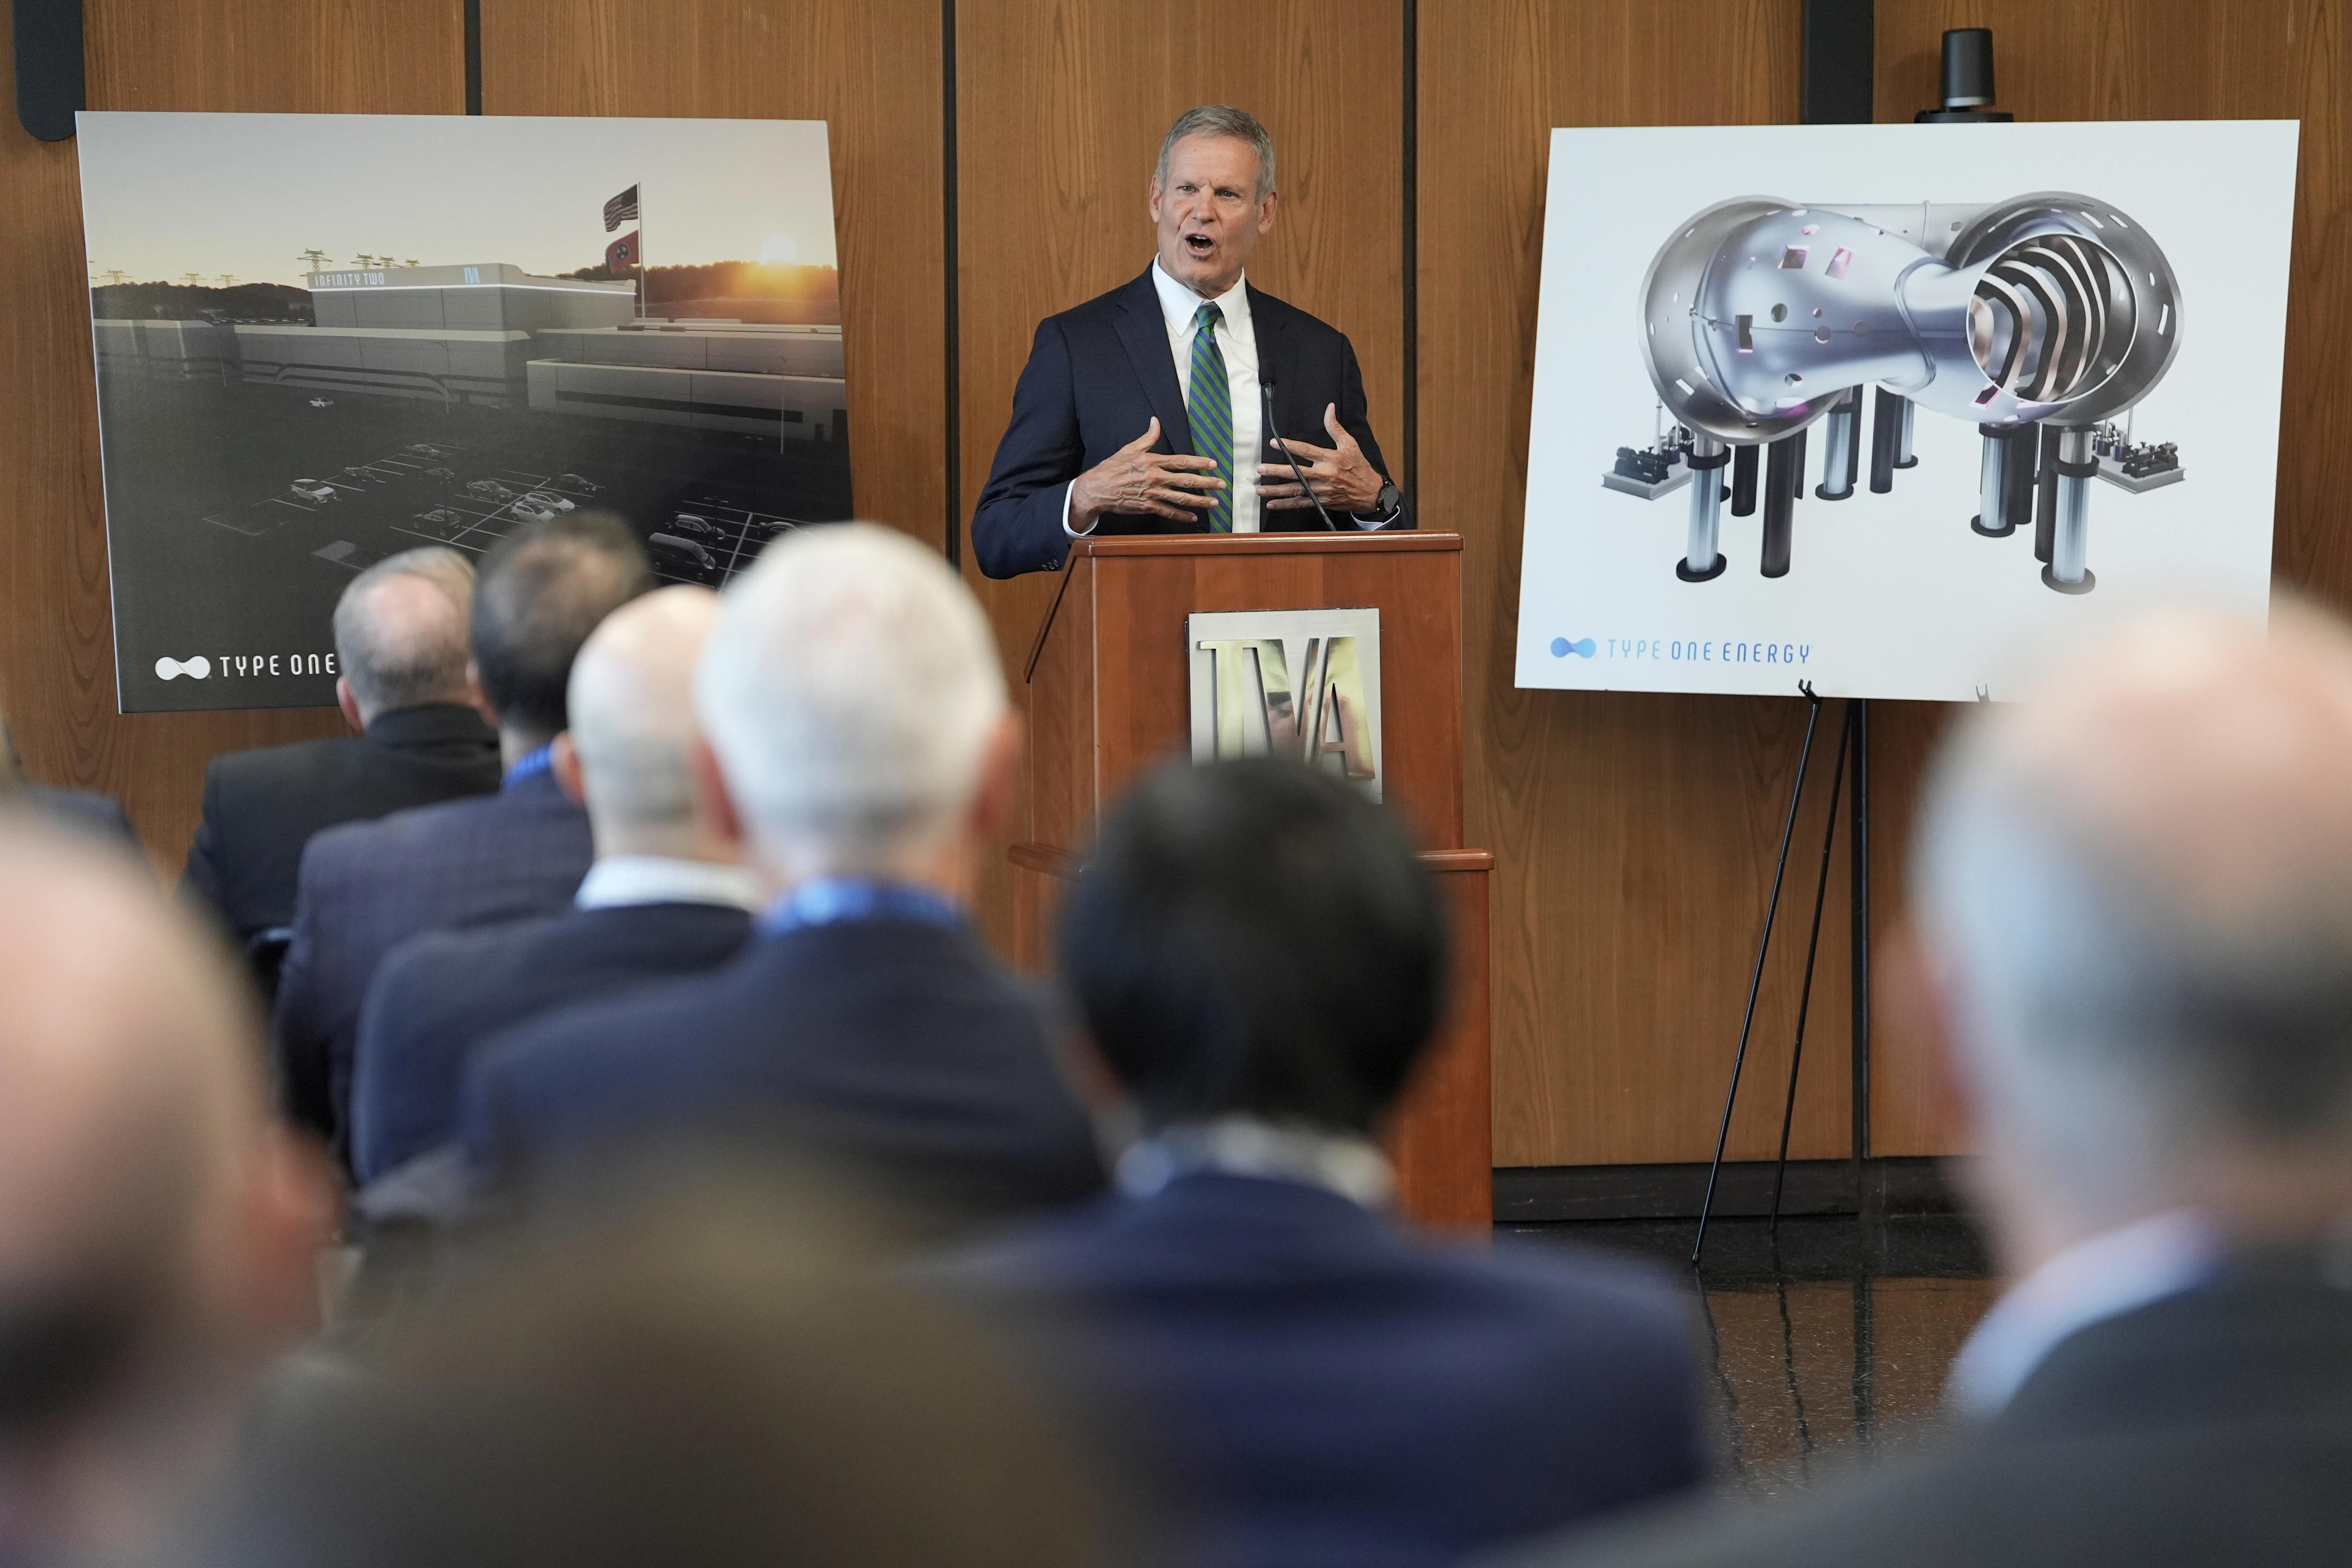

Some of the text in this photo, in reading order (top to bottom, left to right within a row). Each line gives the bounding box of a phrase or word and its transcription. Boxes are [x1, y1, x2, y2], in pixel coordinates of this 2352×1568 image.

[314, 272, 384, 286] INFINITY TWO
[1608, 639, 1810, 664] TYPE ONE ENERGY
[219, 653, 336, 677] TYPE ONE
[1196, 636, 1376, 780] TVA
